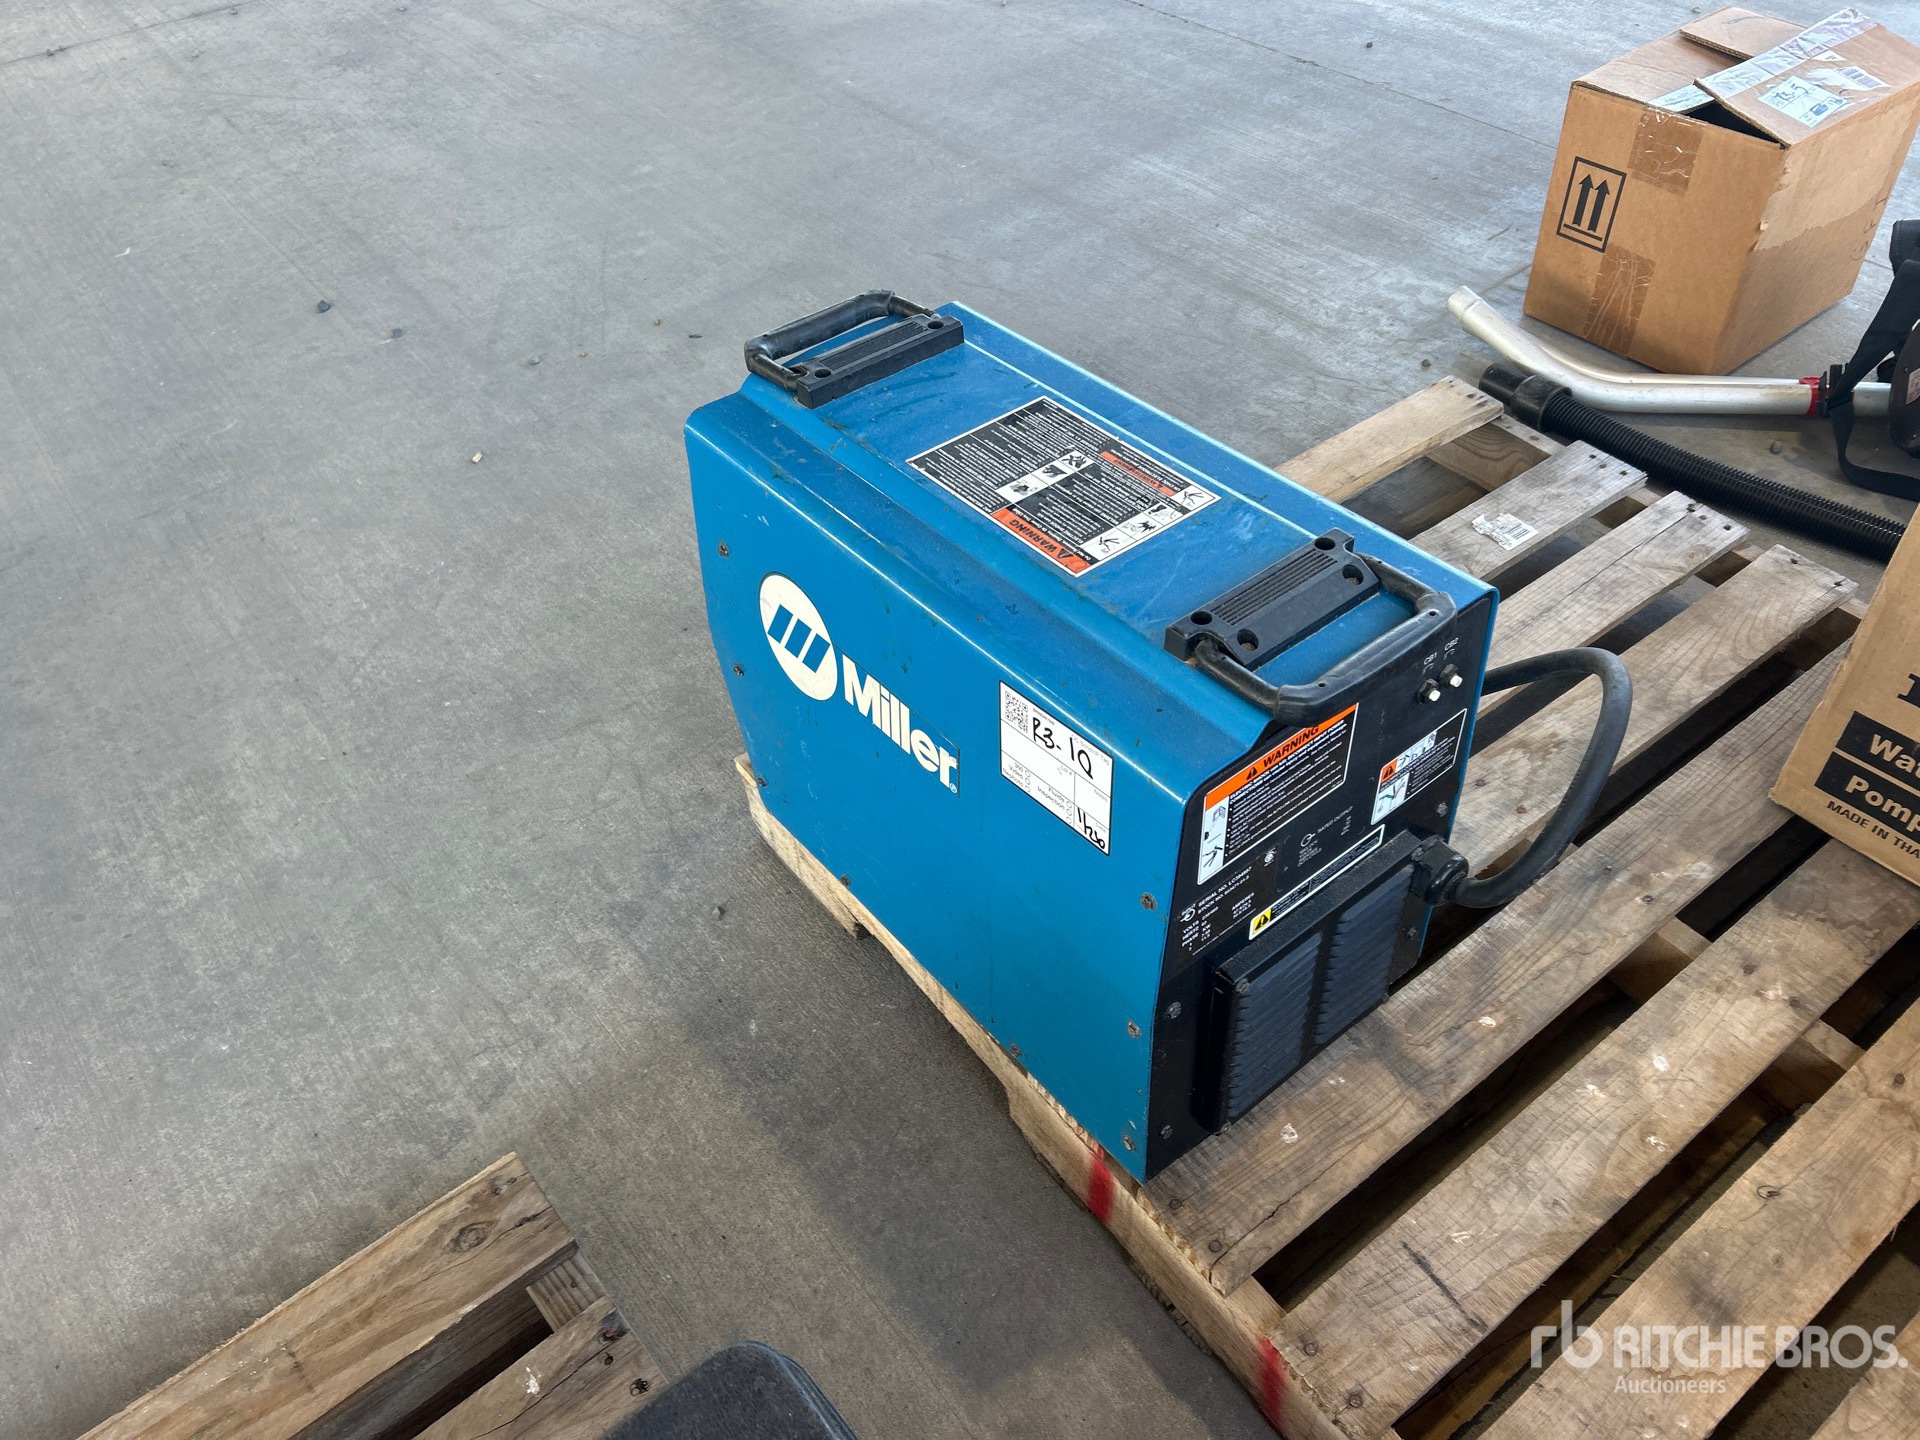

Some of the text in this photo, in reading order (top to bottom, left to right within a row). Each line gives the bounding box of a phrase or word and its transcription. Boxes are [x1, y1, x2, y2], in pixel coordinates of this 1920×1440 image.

[1009, 520, 1057, 551] WARNING
[842, 654, 958, 788] Miller
[1263, 726, 1318, 767] WARNING
[1009, 765, 1022, 779] Video
[1038, 786, 1064, 810] Inspection
[1049, 787, 1064, 802] Fluids
[1827, 801, 1870, 828] MADE
[1871, 825, 1890, 840] IN
